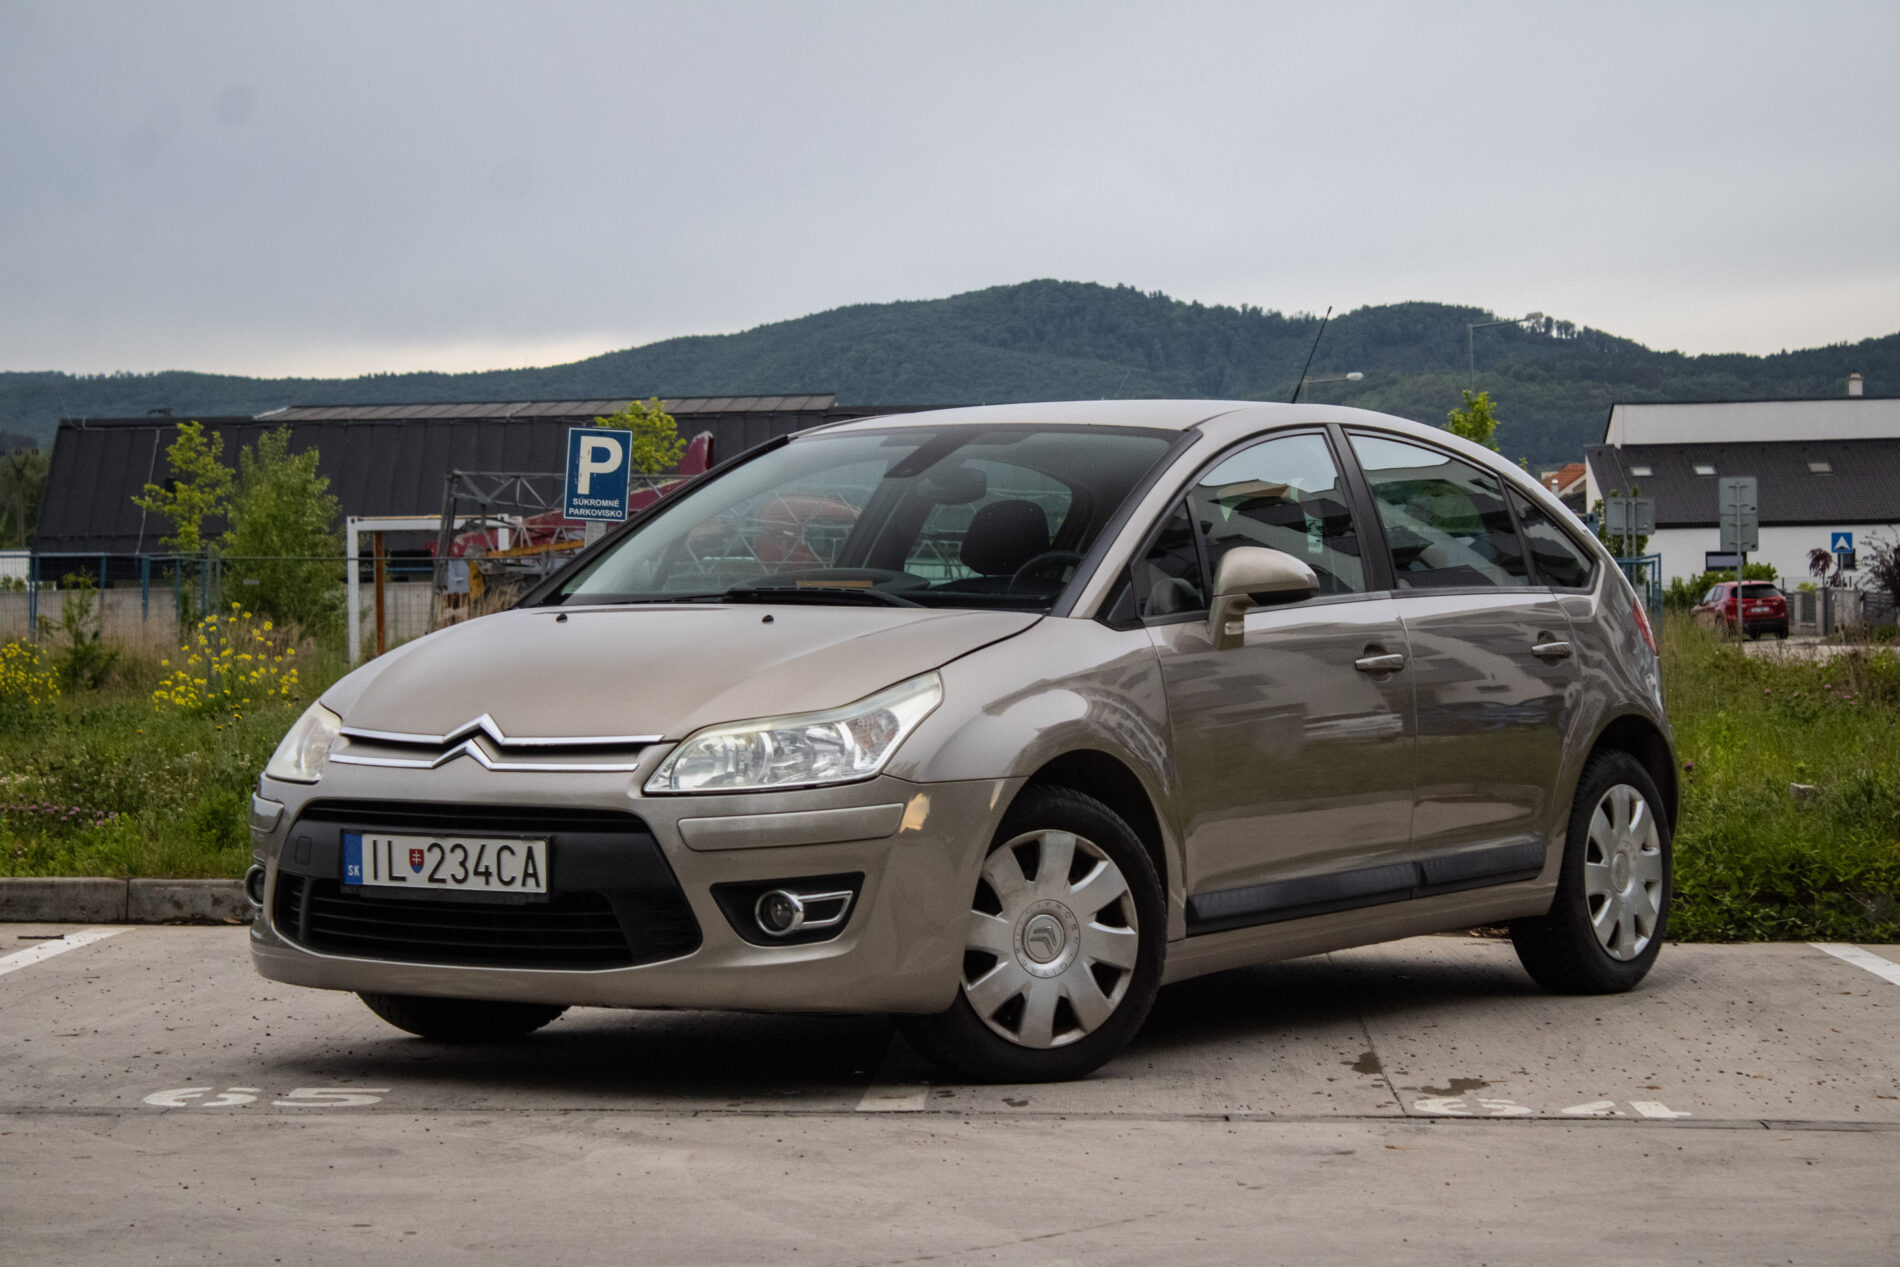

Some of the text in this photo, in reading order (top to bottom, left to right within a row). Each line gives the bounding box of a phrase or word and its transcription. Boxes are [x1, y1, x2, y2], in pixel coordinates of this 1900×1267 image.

[577, 435, 623, 495] P
[568, 507, 623, 518] PARKOVISKO
[572, 497, 620, 508] SÚKROMNÉ
[347, 865, 361, 877] SK
[372, 839, 541, 888] IL 234CA
[142, 1086, 392, 1107] 65
[1413, 1097, 1692, 1118] 64
